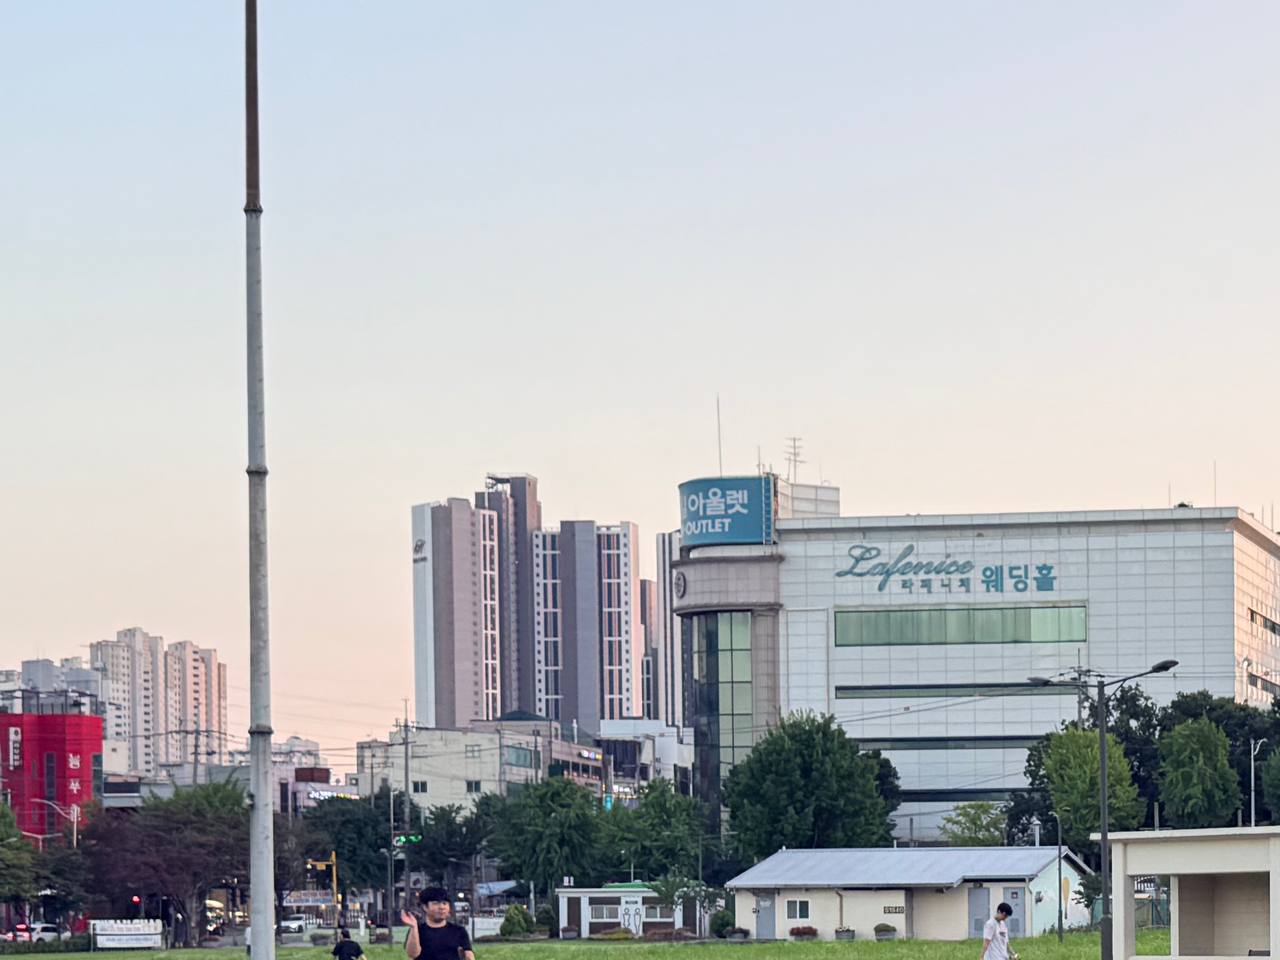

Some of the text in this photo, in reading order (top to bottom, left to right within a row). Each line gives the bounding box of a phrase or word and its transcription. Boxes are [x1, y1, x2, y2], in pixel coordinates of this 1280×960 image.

[687, 487, 748, 516] 아울렛
[684, 518, 732, 535] OUTLET
[835, 543, 976, 592] Lafenice
[981, 563, 1057, 593] 웨딩홀
